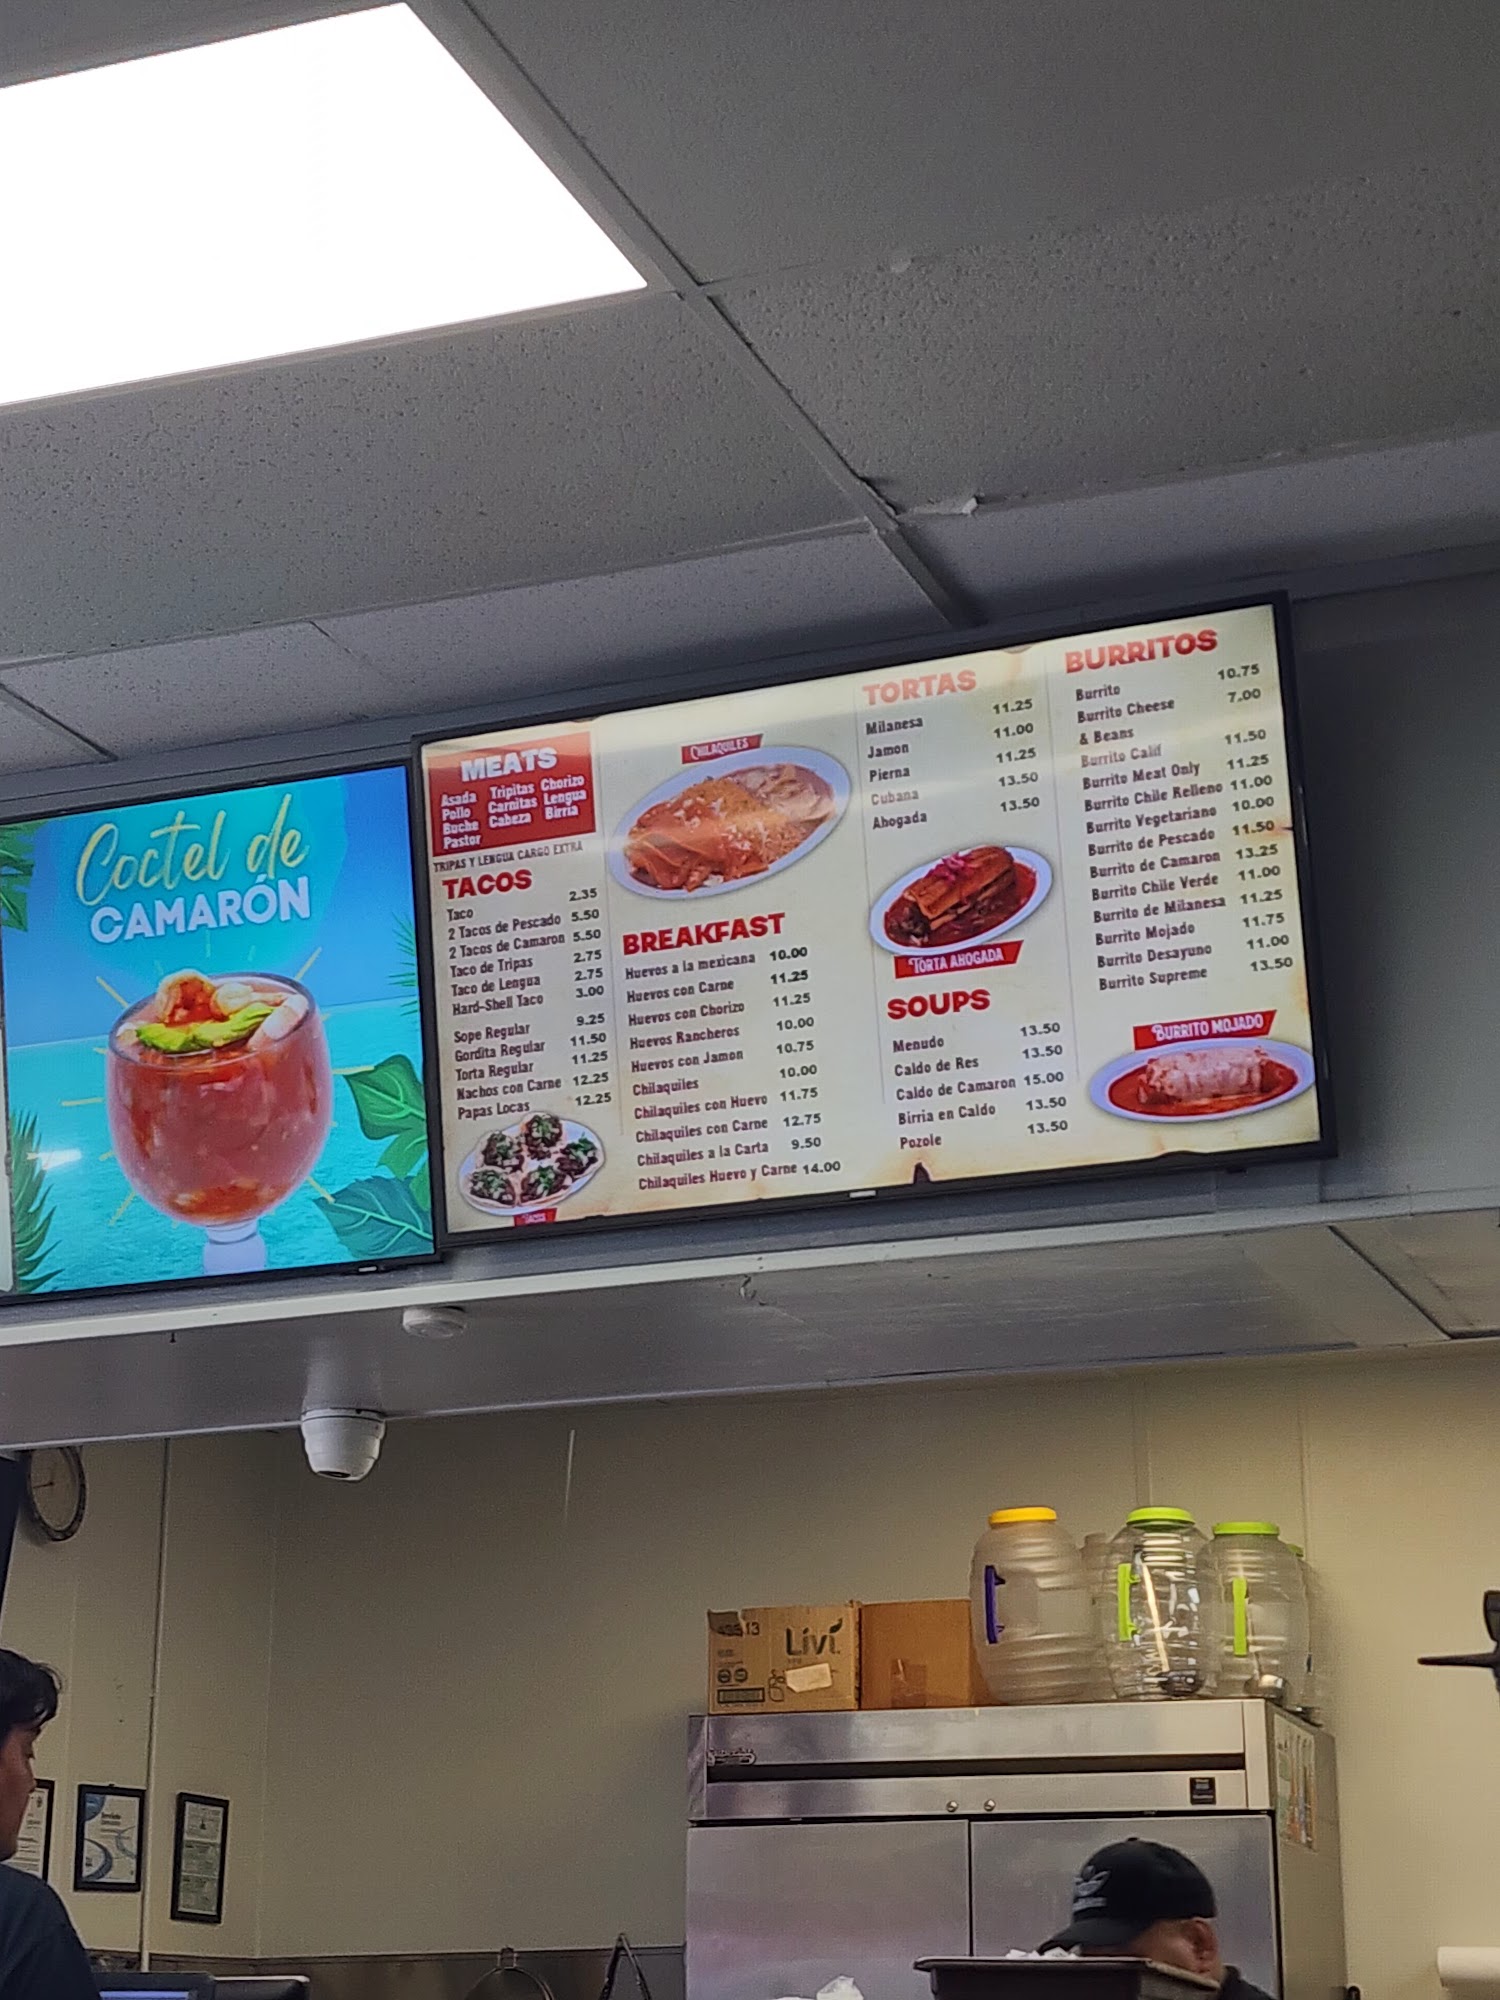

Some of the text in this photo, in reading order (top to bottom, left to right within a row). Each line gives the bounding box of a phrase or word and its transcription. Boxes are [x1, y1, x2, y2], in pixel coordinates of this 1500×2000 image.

[1066, 629, 1217, 673] BURRITOS
[861, 668, 977, 708] TORTAS
[1075, 663, 1260, 701] Burrito 10.75
[865, 698, 1033, 735] Milanesa 11.25
[1077, 687, 1261, 724] Burrito Cheese 7.00
[867, 722, 1034, 759] Jamon 11.00
[1079, 728, 1134, 745] & Beans
[460, 745, 557, 781] MEATS
[869, 746, 1036, 782] Pierna 11.25
[1082, 753, 1269, 790] Burrito Meat Only 11.25
[440, 774, 584, 807] Asada Tripitas Chorizo
[441, 789, 587, 821] Pollo Carnitas Lengua
[870, 771, 1038, 806] Cubana 13.50
[442, 805, 578, 835] Buche Cabeza Birria
[872, 796, 1040, 830] Ahogada 13.50
[1086, 795, 1274, 834] Burrito Vegetariano 10.00
[76, 793, 309, 906] Coctel de
[443, 834, 481, 849] Pastor
[1087, 819, 1275, 856] Burrito de Pescado 11.50
[432, 840, 583, 873] TRIPAS Y LENGUA CARGO EXTRA
[442, 869, 532, 899] TACOS
[1091, 865, 1281, 901] Burrito Chile Verde 11.00
[90, 873, 311, 944] CAMARÓN
[446, 887, 597, 922] Taco 2.35
[447, 908, 599, 940] 2 Tacos de Pescado 5.50
[622, 912, 785, 955] BREAKFAST
[1095, 912, 1285, 946] Burrito Mojado 11.75
[448, 928, 601, 959] 2 Tacos de Camaron 5.50
[908, 947, 1004, 973] TORTA AHOGADA
[1097, 934, 1289, 968] Burrito Desayuno 11.00
[449, 949, 602, 978] Taco de Tripas 2.75
[625, 946, 807, 980] Huevos a la mexicana 10.00
[1098, 956, 1293, 991] Burrito Supreme 13.50
[450, 967, 603, 997] Taco de Lengua 2.75
[626, 969, 808, 1003] Huevos con Carne 11.25
[451, 985, 604, 1016] Hard-Shell Taco 3.00
[887, 988, 990, 1020] SOUPS
[453, 1012, 605, 1044] Sope Regular 9.25
[629, 1016, 814, 1049] Huevos Rancheros 10.00
[892, 1021, 1060, 1053] Menudo 13.50
[1150, 1012, 1264, 1042] BURRITO MOJADO
[454, 1032, 607, 1062] Gordita Regular 11.50
[630, 1039, 814, 1073] Huevos con Jamon 10.75
[894, 1044, 1063, 1077] Caldo de Res 13.50
[454, 1050, 608, 1081] Torta Regular 11.25
[632, 1064, 817, 1096] Chilaquiles 10.00
[456, 1071, 609, 1101] Nachos con Carne 12.25
[633, 1086, 818, 1119] Chilaquiles con Huevo 11.75
[896, 1071, 1064, 1101] Caldo de Camaron 15.00
[457, 1091, 612, 1121] Papas Locas 12.25
[899, 1119, 1068, 1149] Pozole 13.50
[638, 1160, 841, 1190] Chilaquiles Huevo y Carne 14.00
